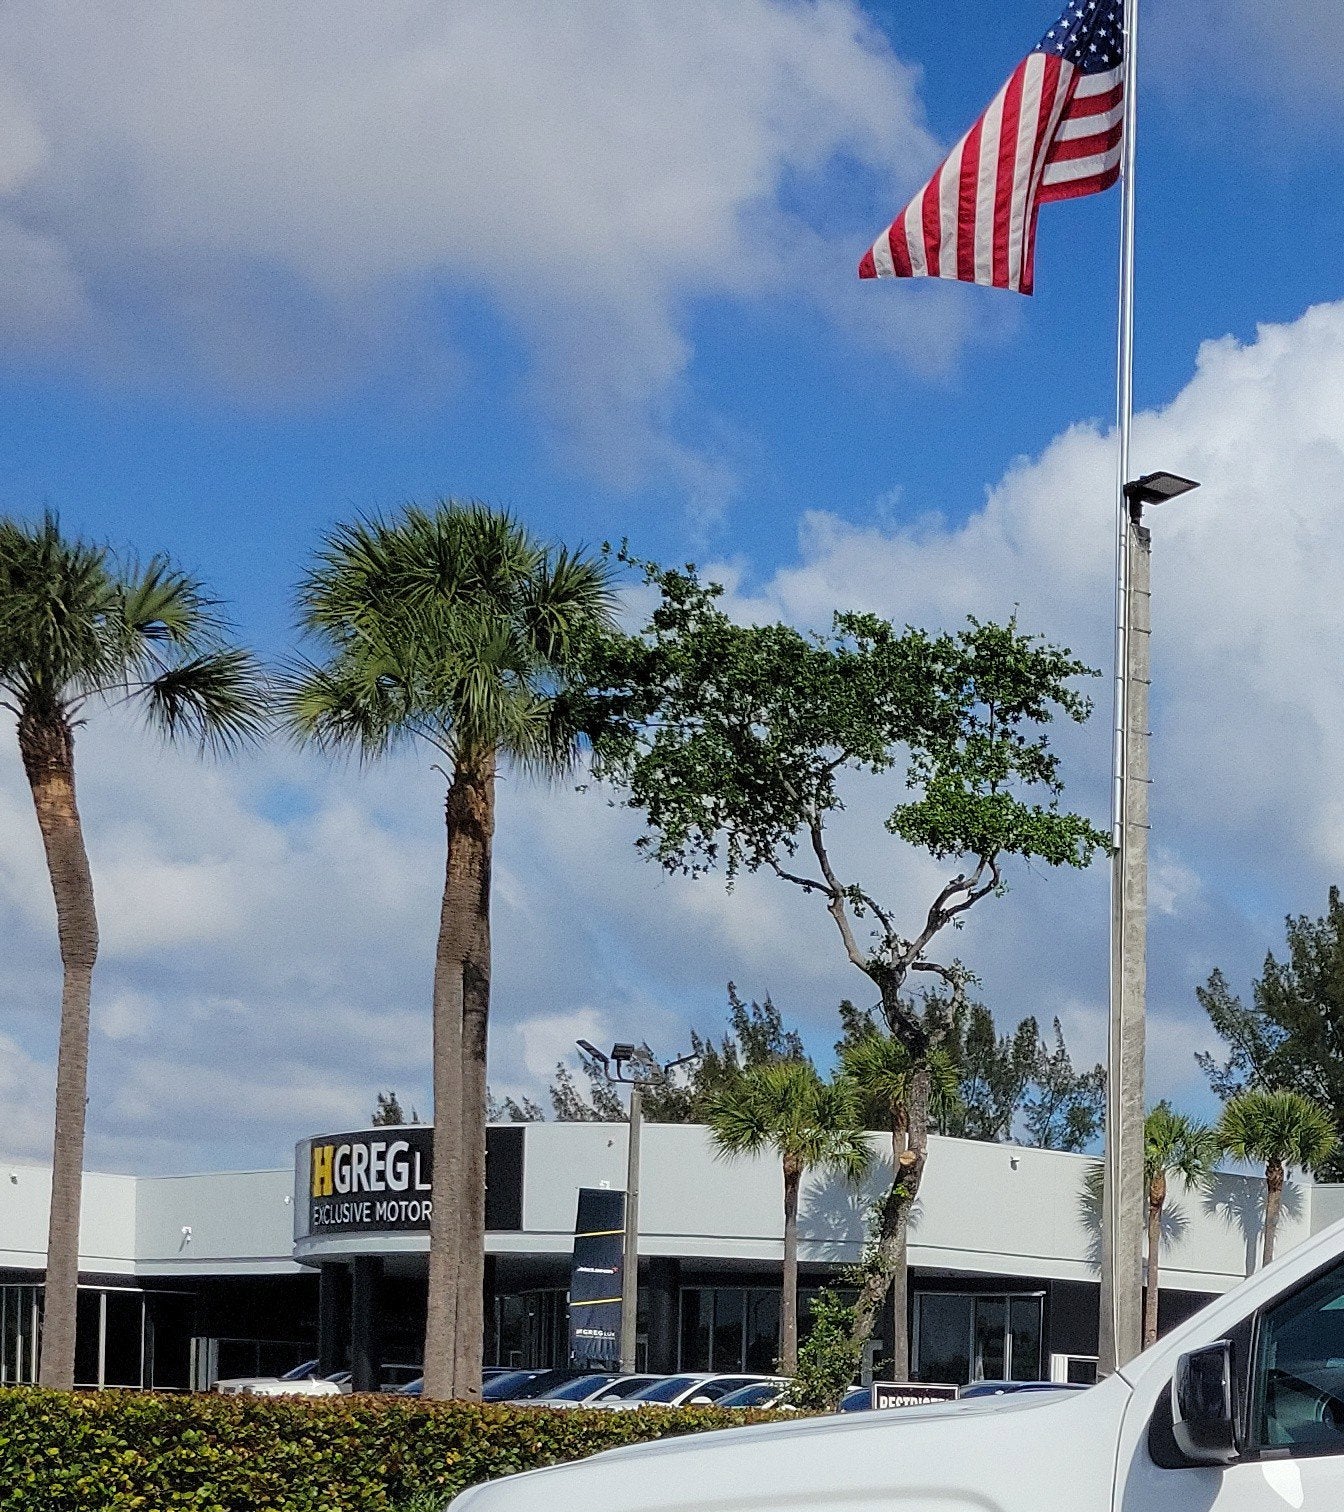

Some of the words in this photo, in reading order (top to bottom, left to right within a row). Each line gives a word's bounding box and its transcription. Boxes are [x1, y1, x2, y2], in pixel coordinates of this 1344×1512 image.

[313, 1140, 410, 1198] HGREG
[313, 1202, 372, 1226] EXCLUSIVE
[375, 1201, 432, 1223] MOTOR
[879, 1396, 949, 1409] RESTRI
